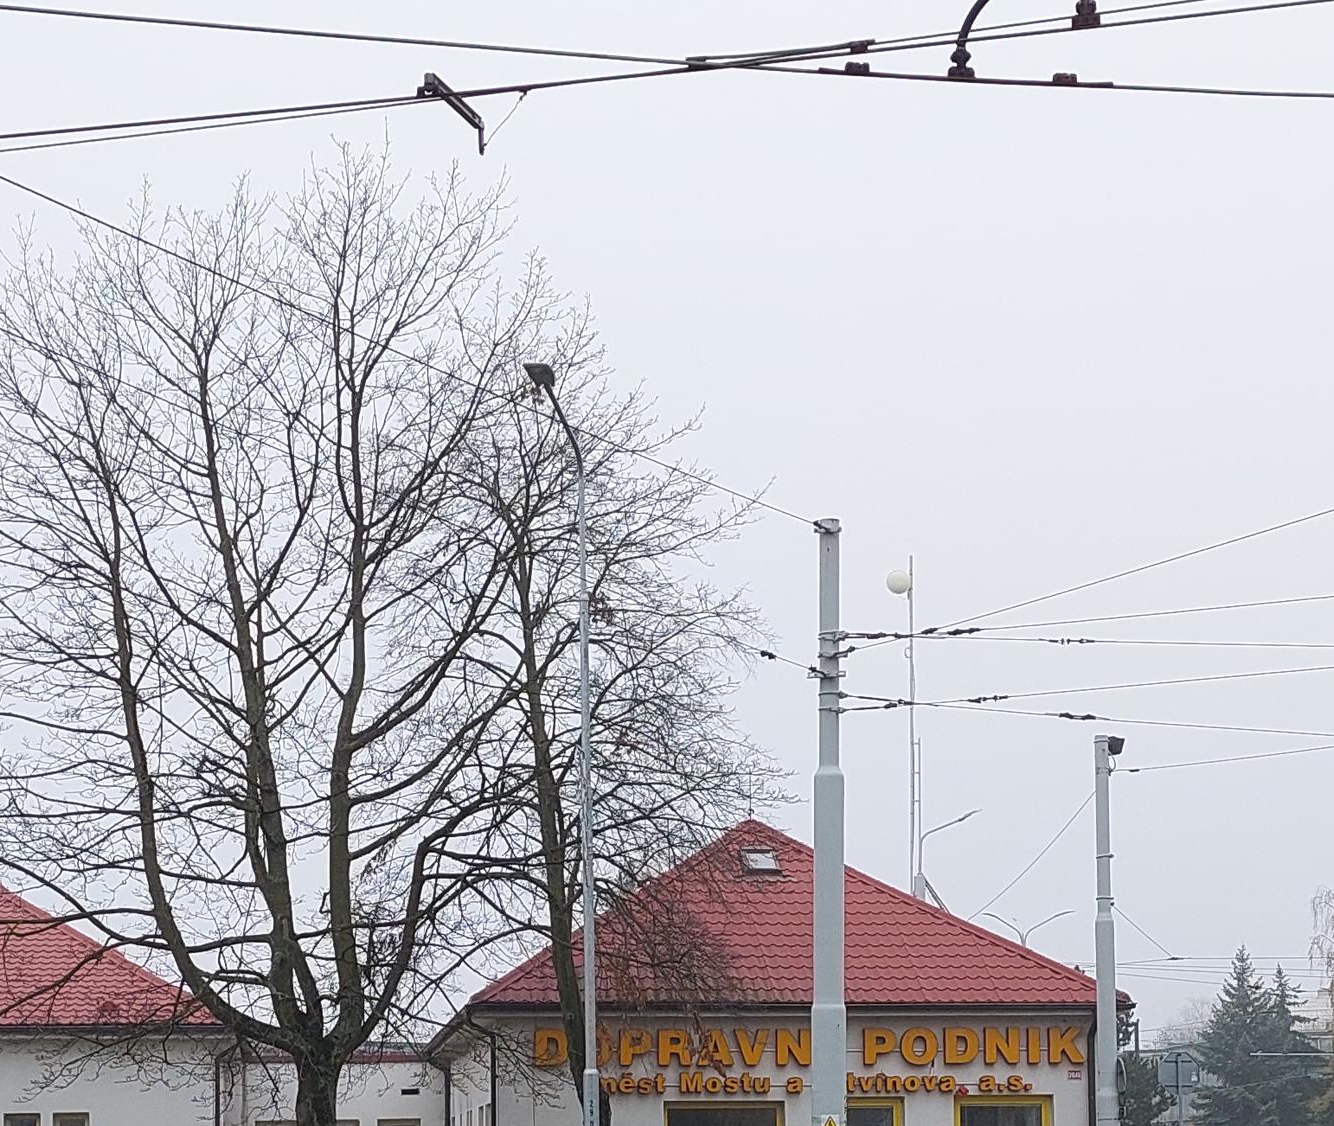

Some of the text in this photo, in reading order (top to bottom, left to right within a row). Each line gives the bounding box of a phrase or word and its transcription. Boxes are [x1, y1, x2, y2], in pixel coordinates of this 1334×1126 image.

[533, 1026, 1085, 1067] DPRAVN PODNIK
[679, 1071, 771, 1094] Mostu
[786, 1076, 803, 1093] a
[978, 1074, 1033, 1093] a.s.
